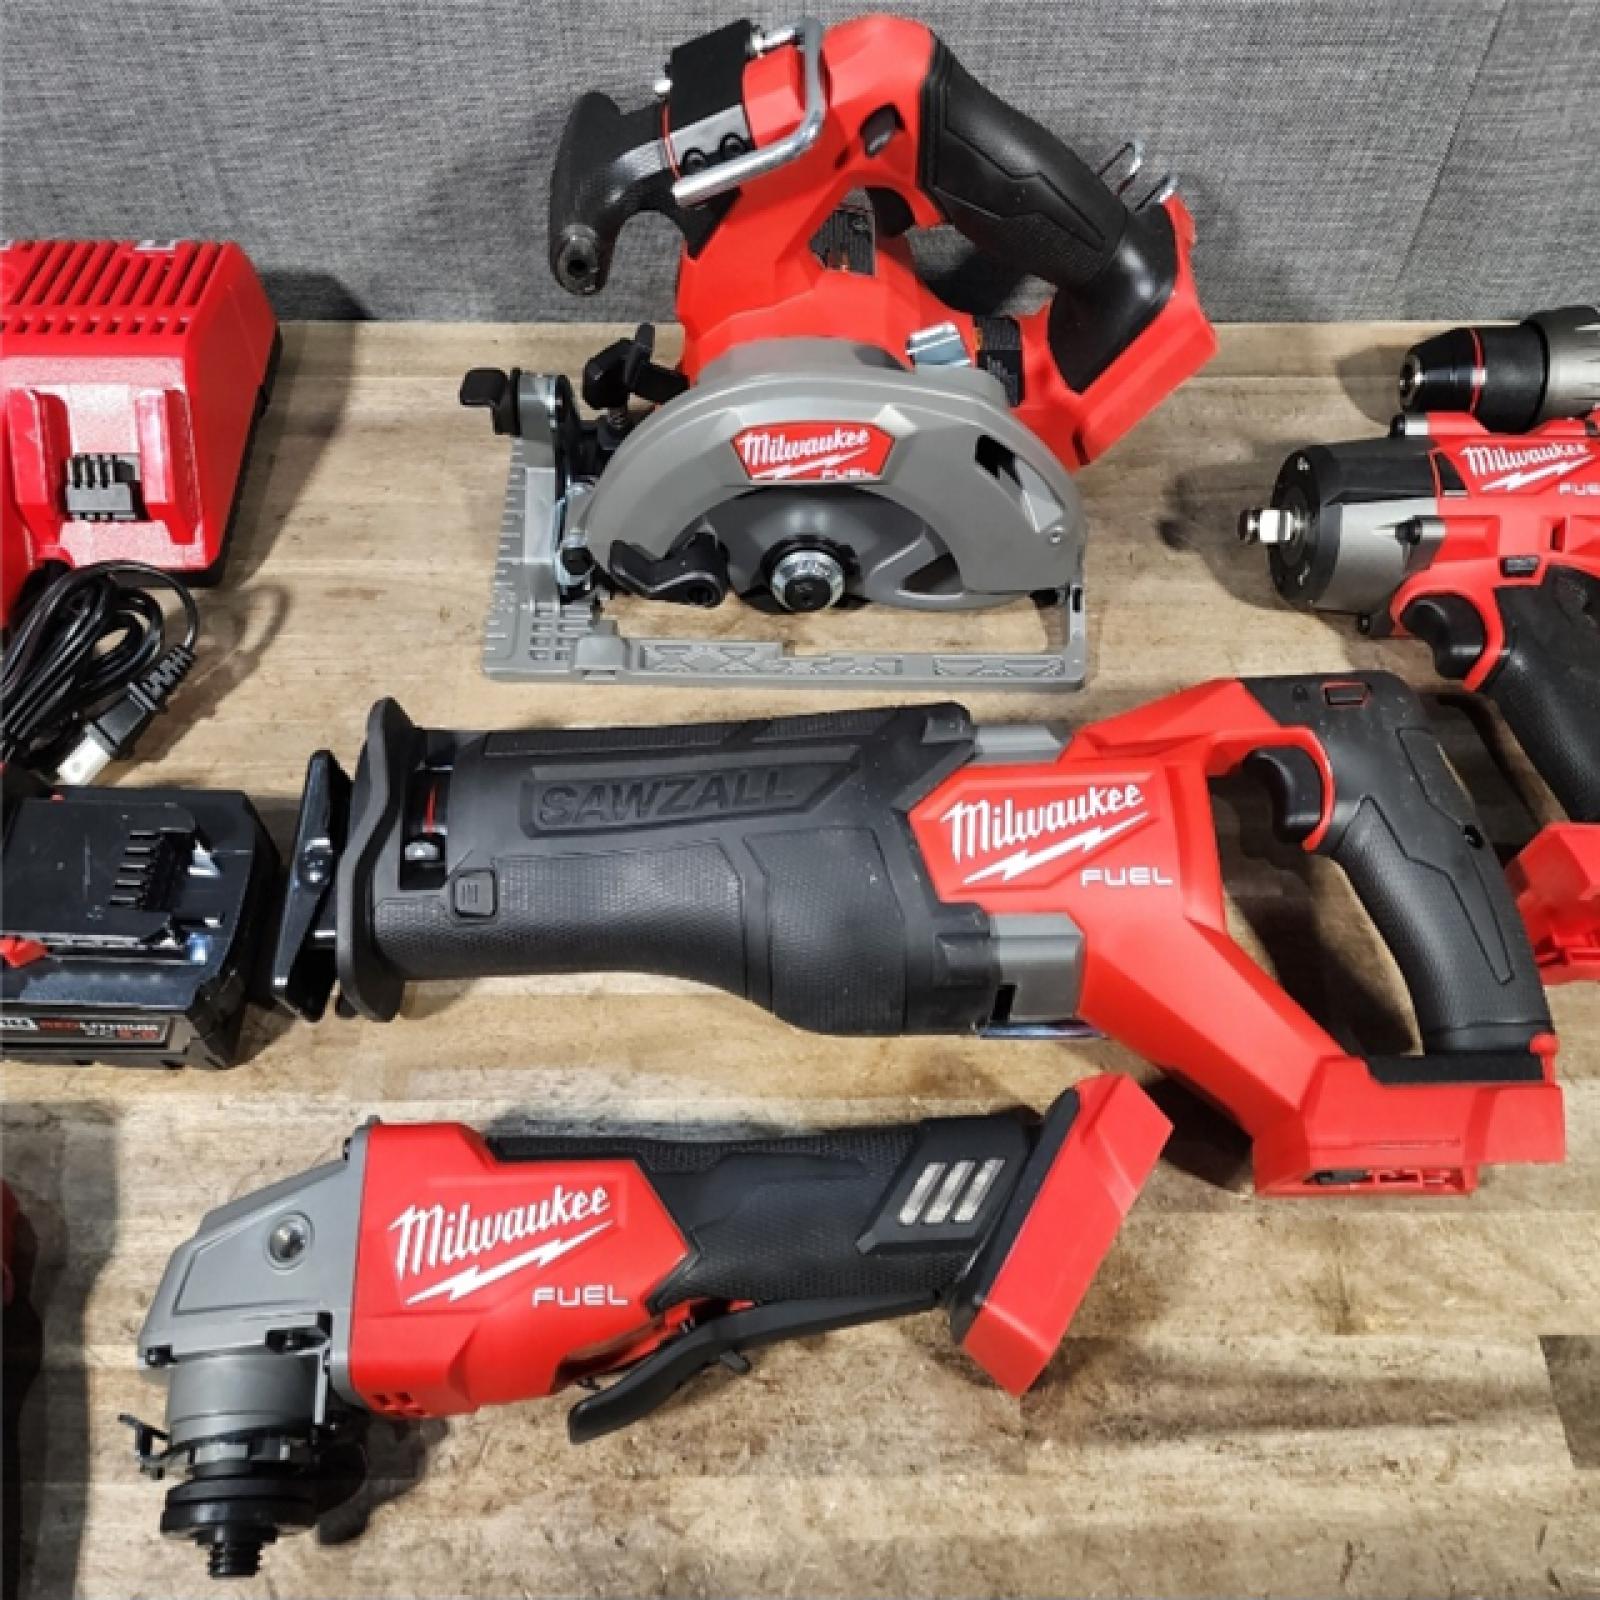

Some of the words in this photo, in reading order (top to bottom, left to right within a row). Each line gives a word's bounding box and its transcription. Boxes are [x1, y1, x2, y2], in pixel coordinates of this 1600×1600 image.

[737, 427, 869, 467] Milwaukee
[1459, 442, 1588, 477] Milwaukee
[539, 770, 796, 826] SAWZALL
[940, 783, 1146, 865] Milwaukee
[1080, 866, 1174, 888] FUEL
[387, 1184, 611, 1281] Milwaukee
[532, 1284, 630, 1309] FUEL
